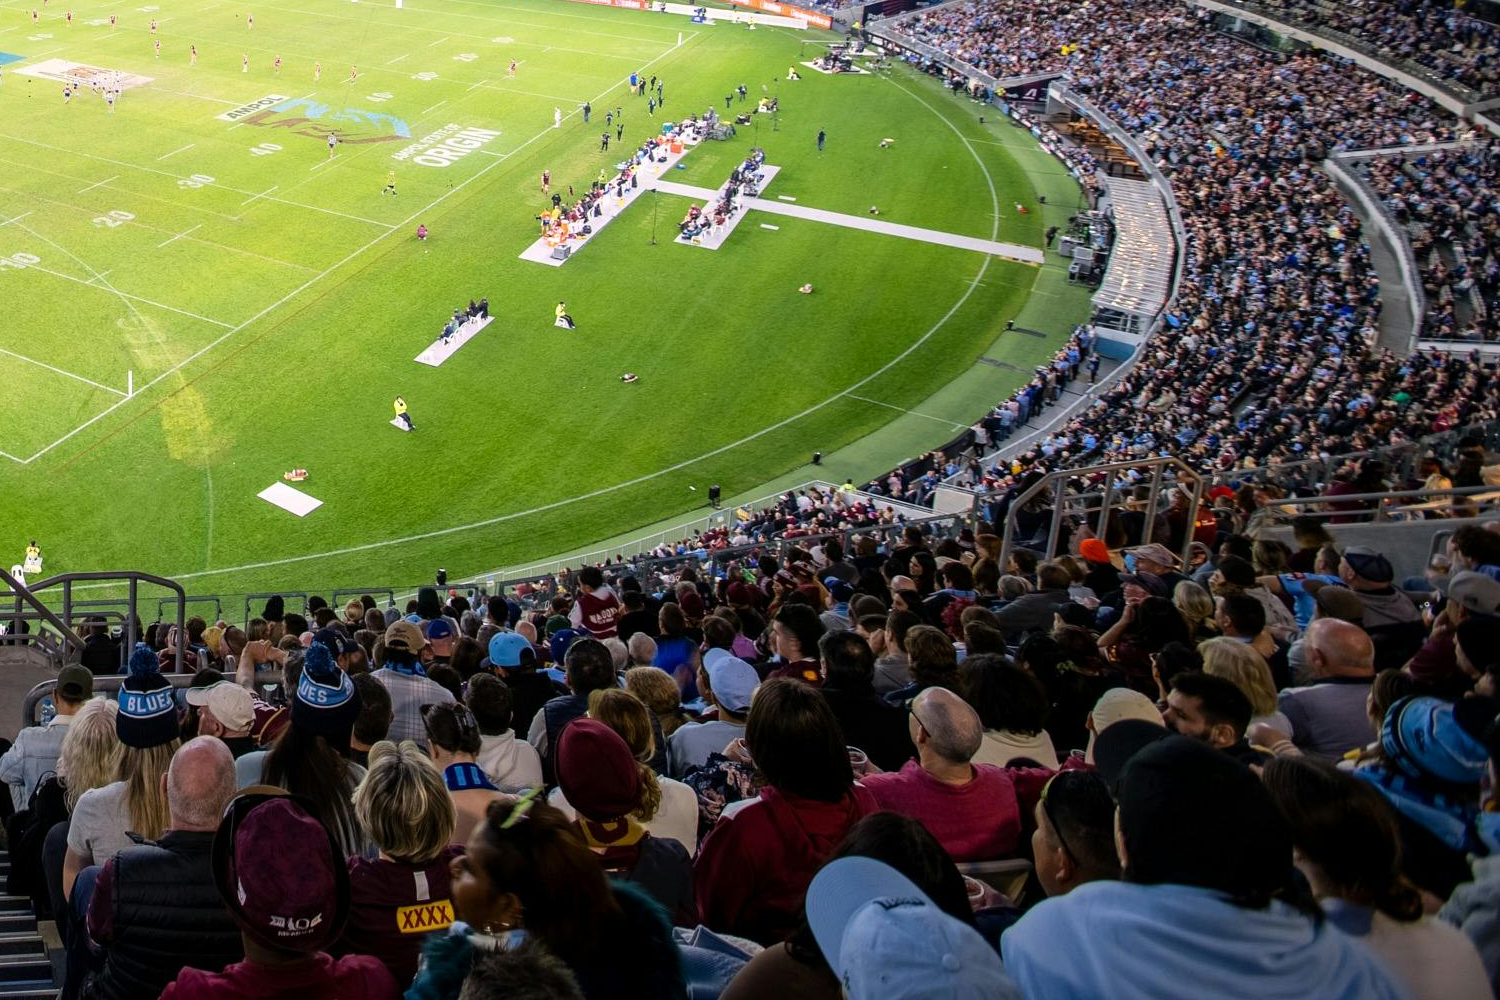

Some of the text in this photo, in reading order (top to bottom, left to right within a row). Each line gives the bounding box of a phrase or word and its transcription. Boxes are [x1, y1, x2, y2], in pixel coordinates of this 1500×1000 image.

[226, 96, 283, 120] AMPOL
[249, 142, 283, 157] 40
[413, 127, 502, 168] ORIGIN
[177, 174, 215, 189] 30
[92, 210, 136, 228] 20
[0, 252, 41, 271] 10
[300, 680, 328, 703] UES
[402, 905, 452, 929] XXXX
